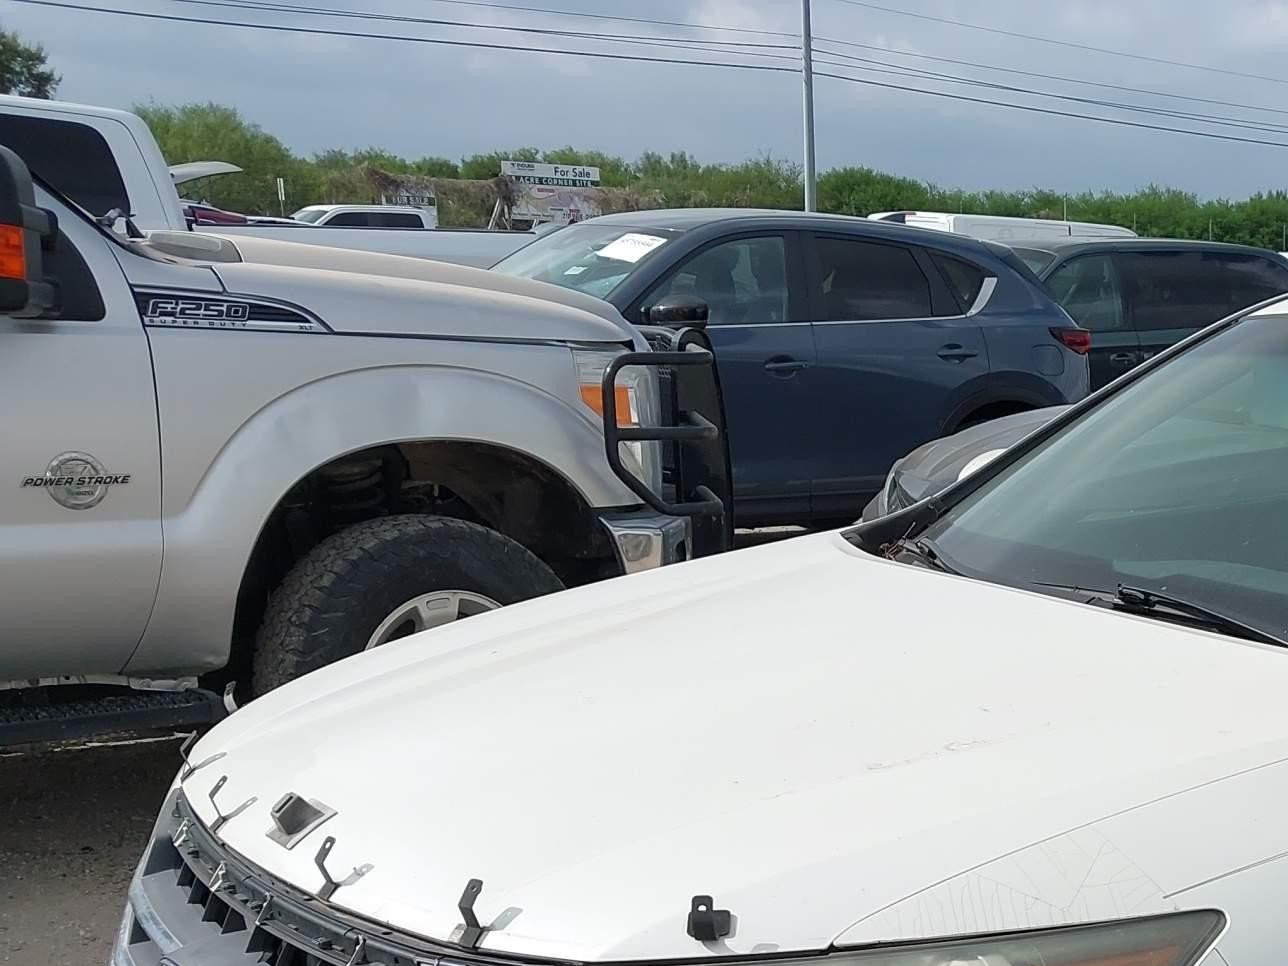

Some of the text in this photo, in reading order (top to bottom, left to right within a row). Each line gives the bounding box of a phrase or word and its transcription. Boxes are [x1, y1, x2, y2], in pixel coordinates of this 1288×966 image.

[554, 167, 591, 179] For Sale
[519, 176, 540, 184] ACRE
[542, 177, 573, 186] CORNER
[409, 196, 429, 205] SALE
[148, 318, 248, 328] SUPER DUTY
[22, 474, 131, 488] POWER STROKE
